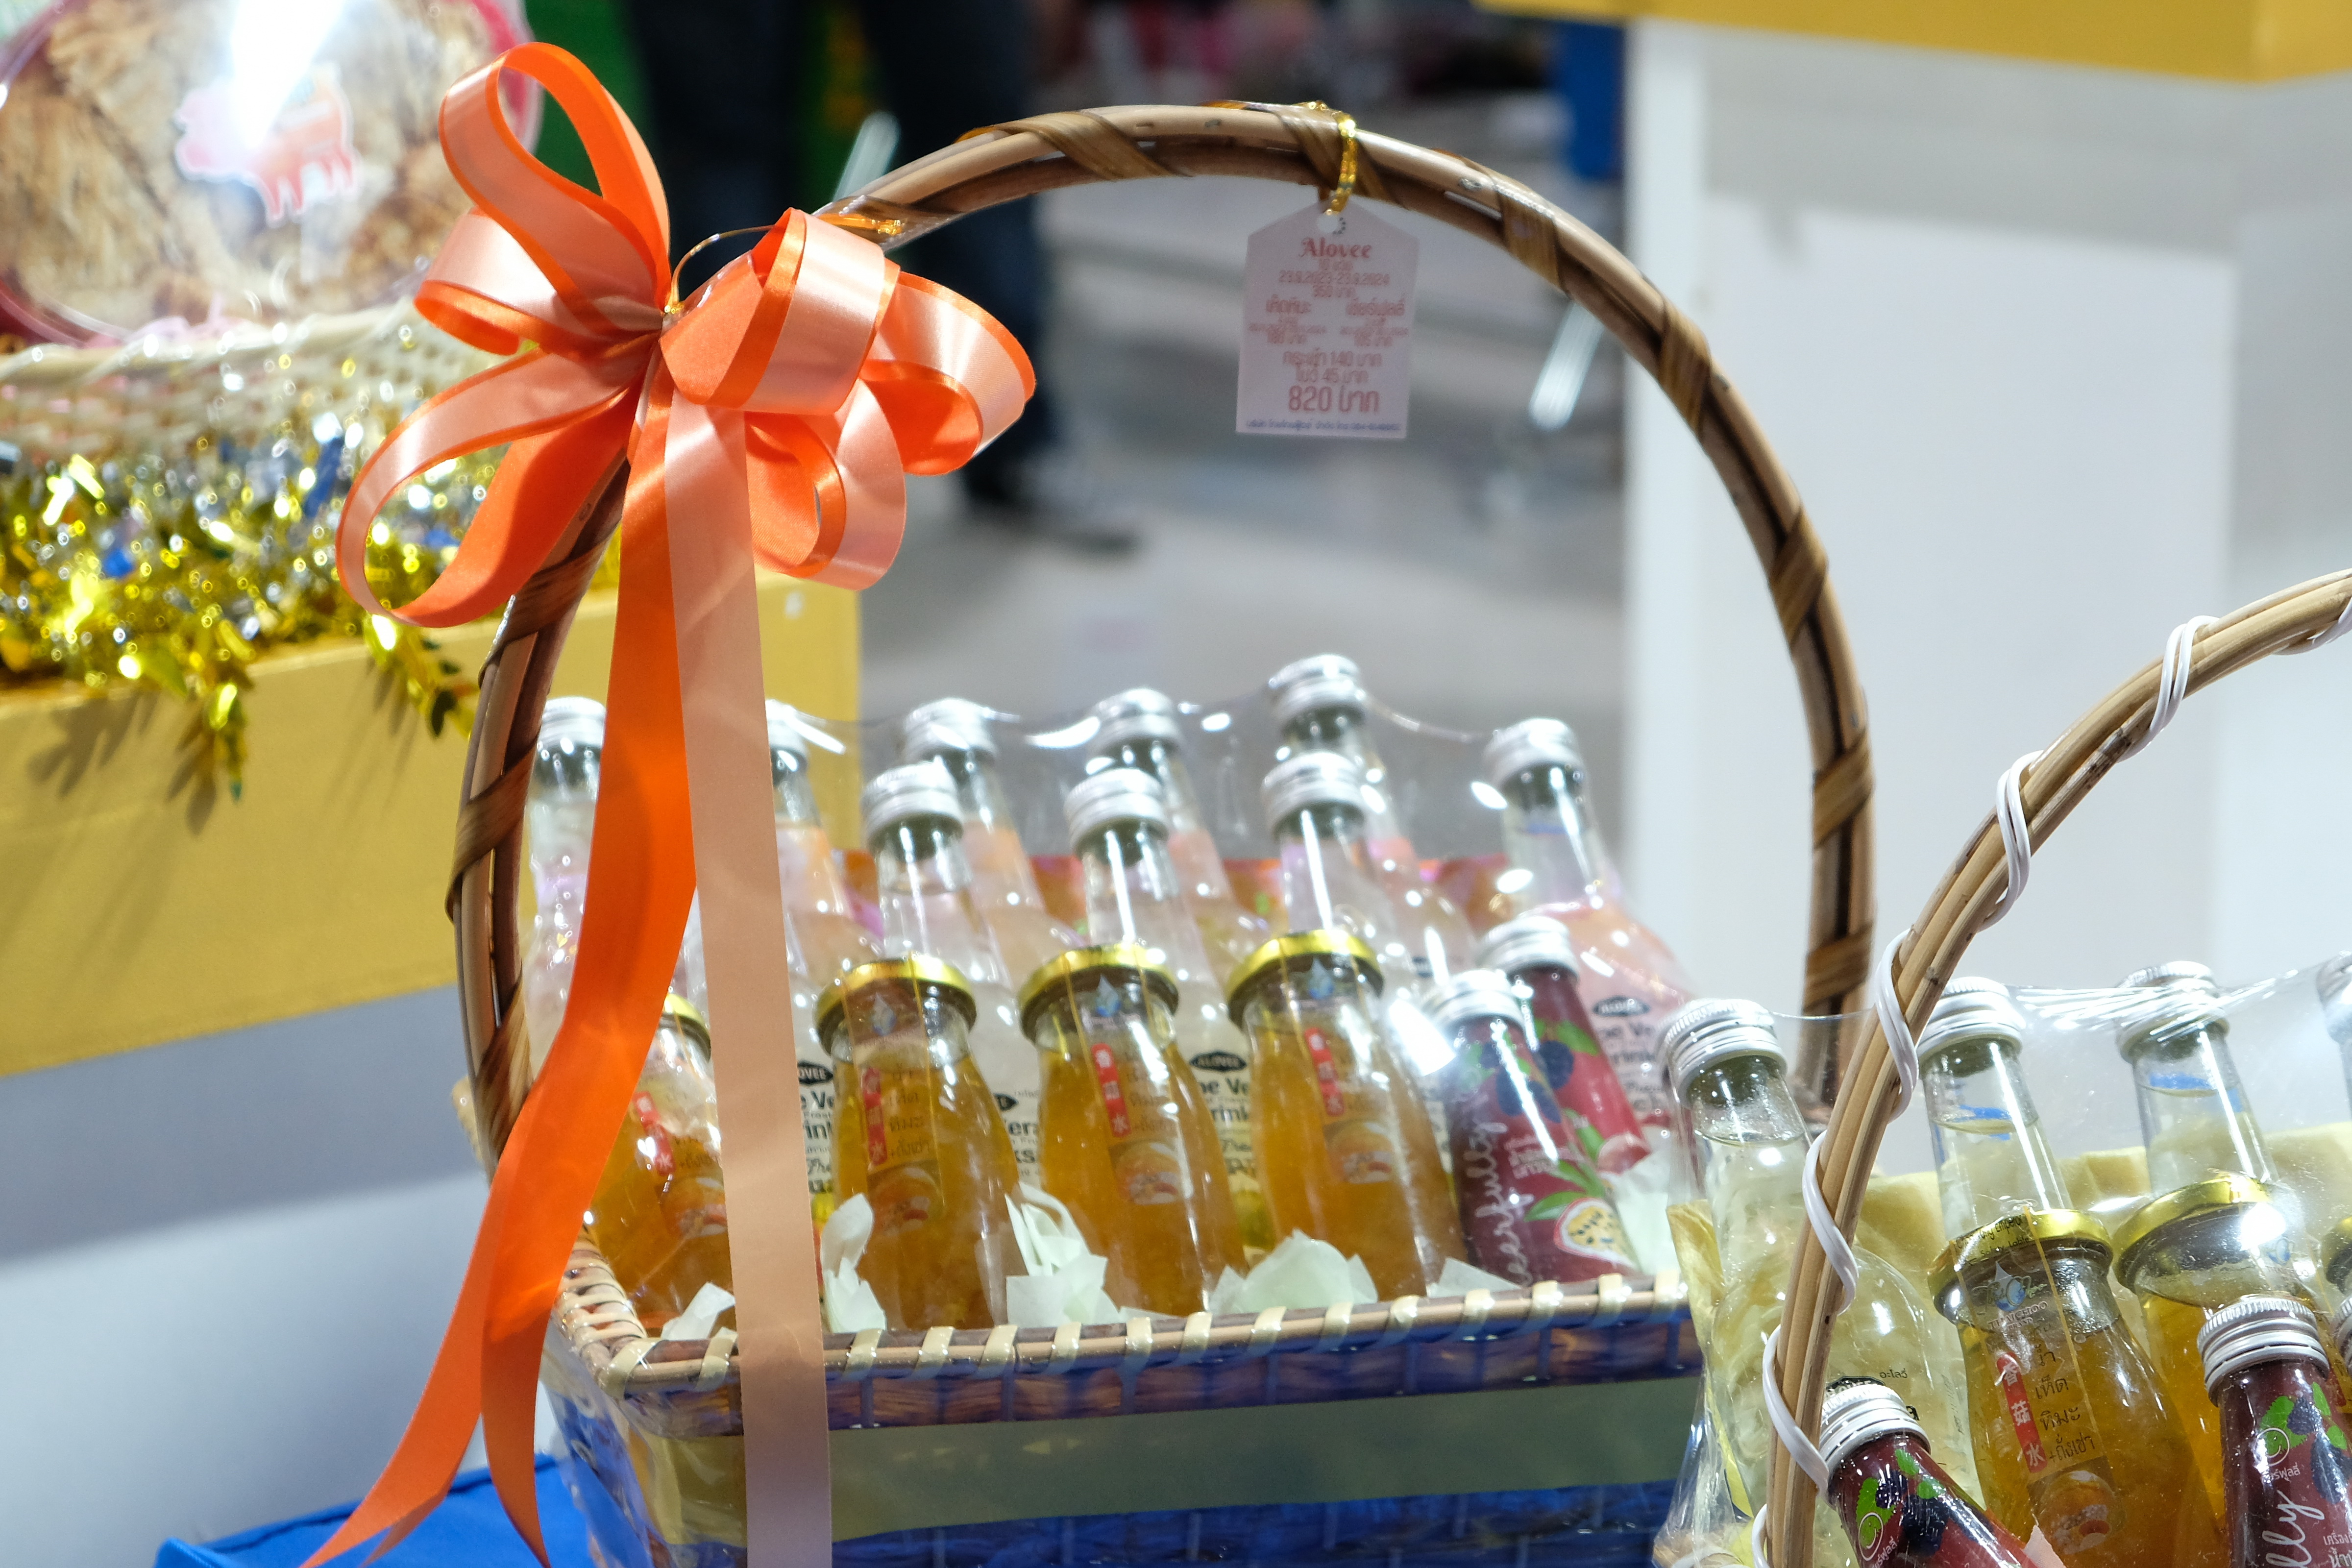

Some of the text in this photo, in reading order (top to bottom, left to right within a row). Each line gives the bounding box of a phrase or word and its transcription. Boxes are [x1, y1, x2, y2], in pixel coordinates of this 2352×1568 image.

[1300, 237, 1372, 259] Alovee
[1331, 351, 1354, 367] 140
[1323, 368, 1339, 383] 45
[1288, 385, 1380, 413] 820 บาท
[2009, 1317, 2033, 1329] BRAND
